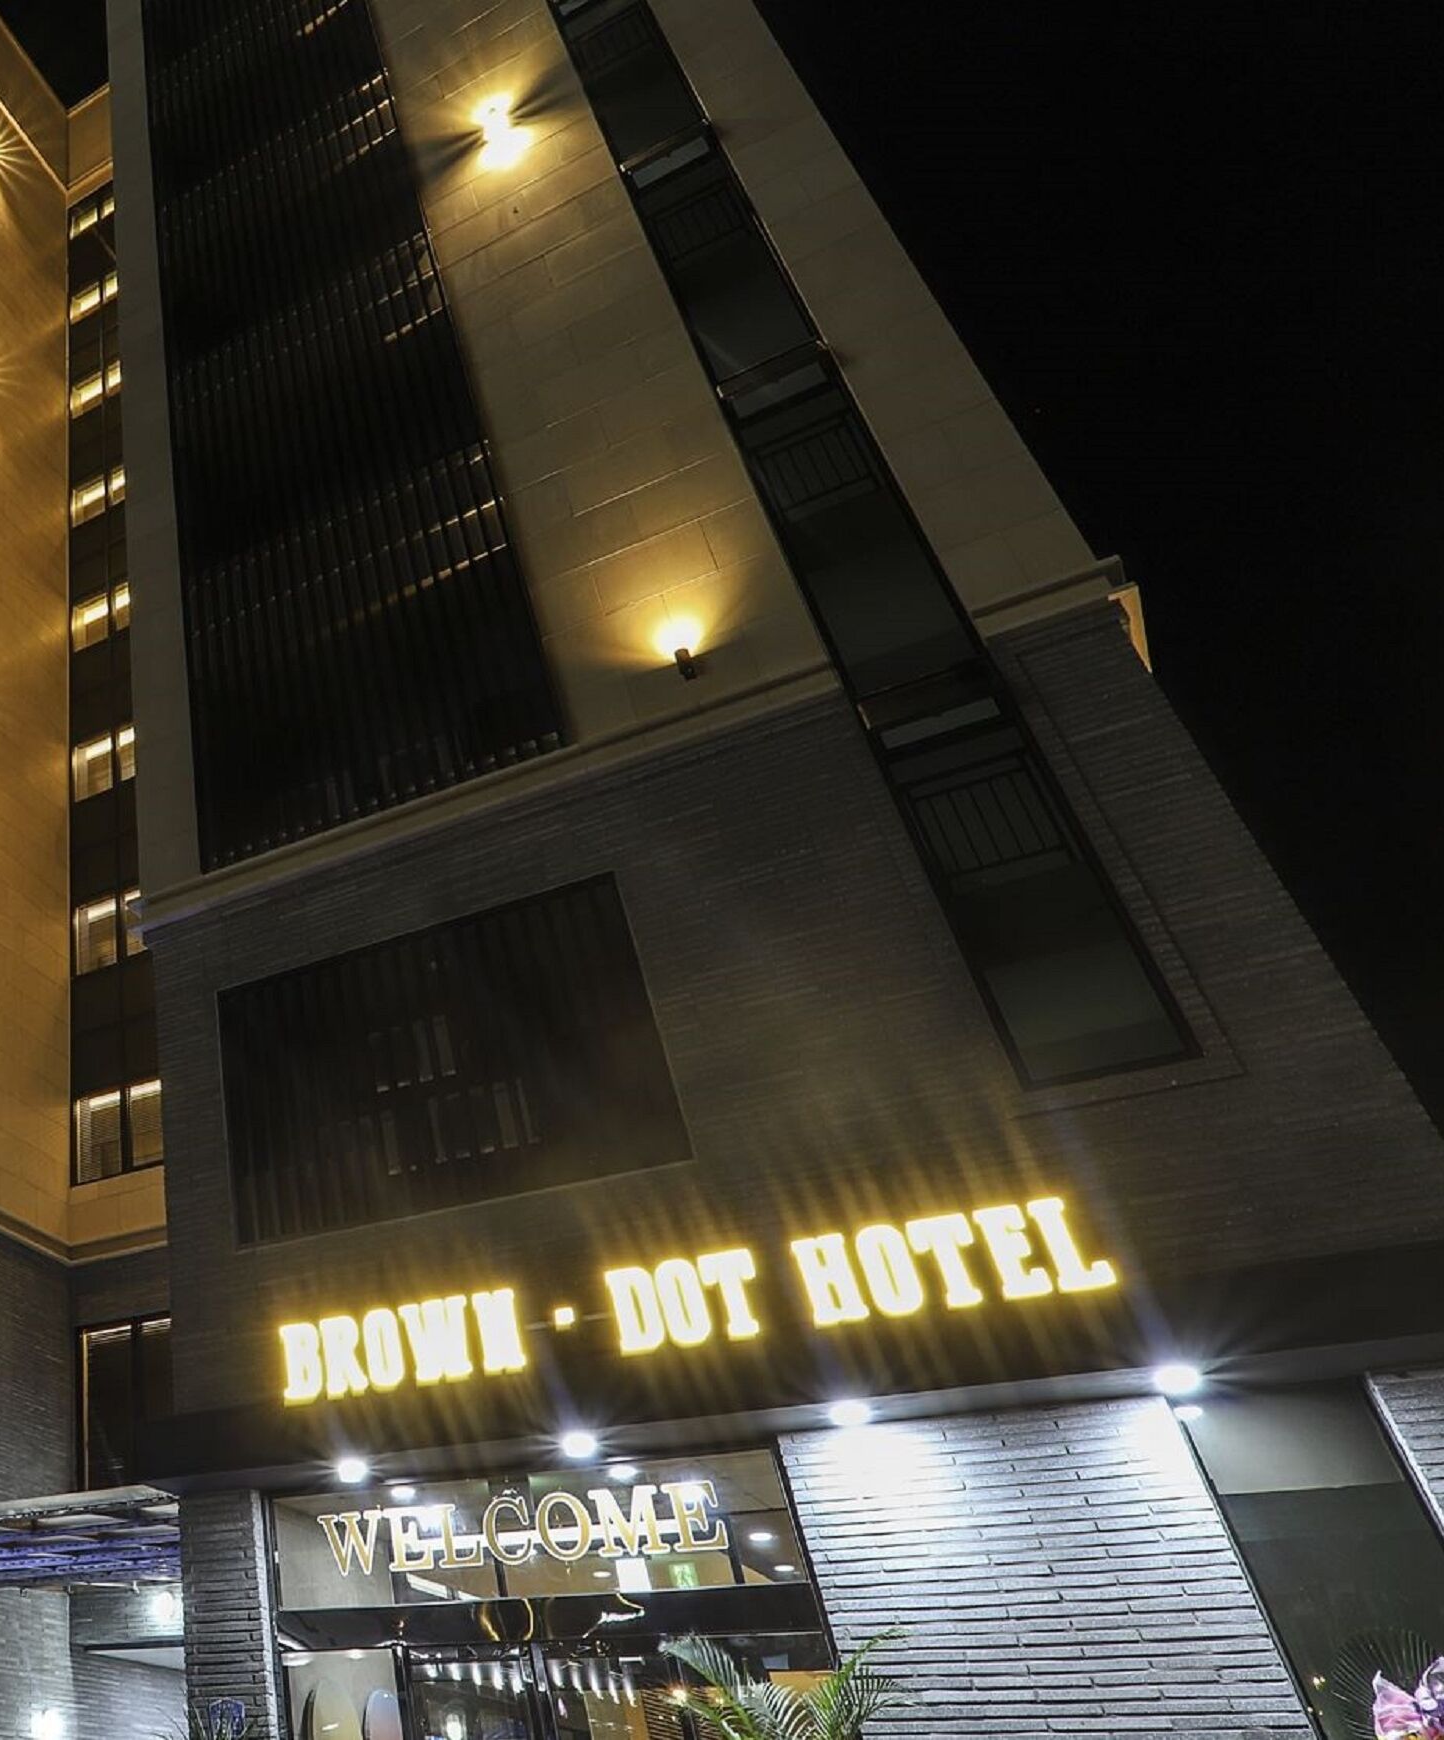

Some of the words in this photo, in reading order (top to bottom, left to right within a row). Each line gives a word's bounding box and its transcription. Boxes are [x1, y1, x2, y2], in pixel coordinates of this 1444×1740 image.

[278, 1287, 527, 1405] BROWN
[604, 1247, 759, 1356] DOT
[790, 1196, 1116, 1327] HOTEL
[318, 1481, 728, 1576] WELCOME
